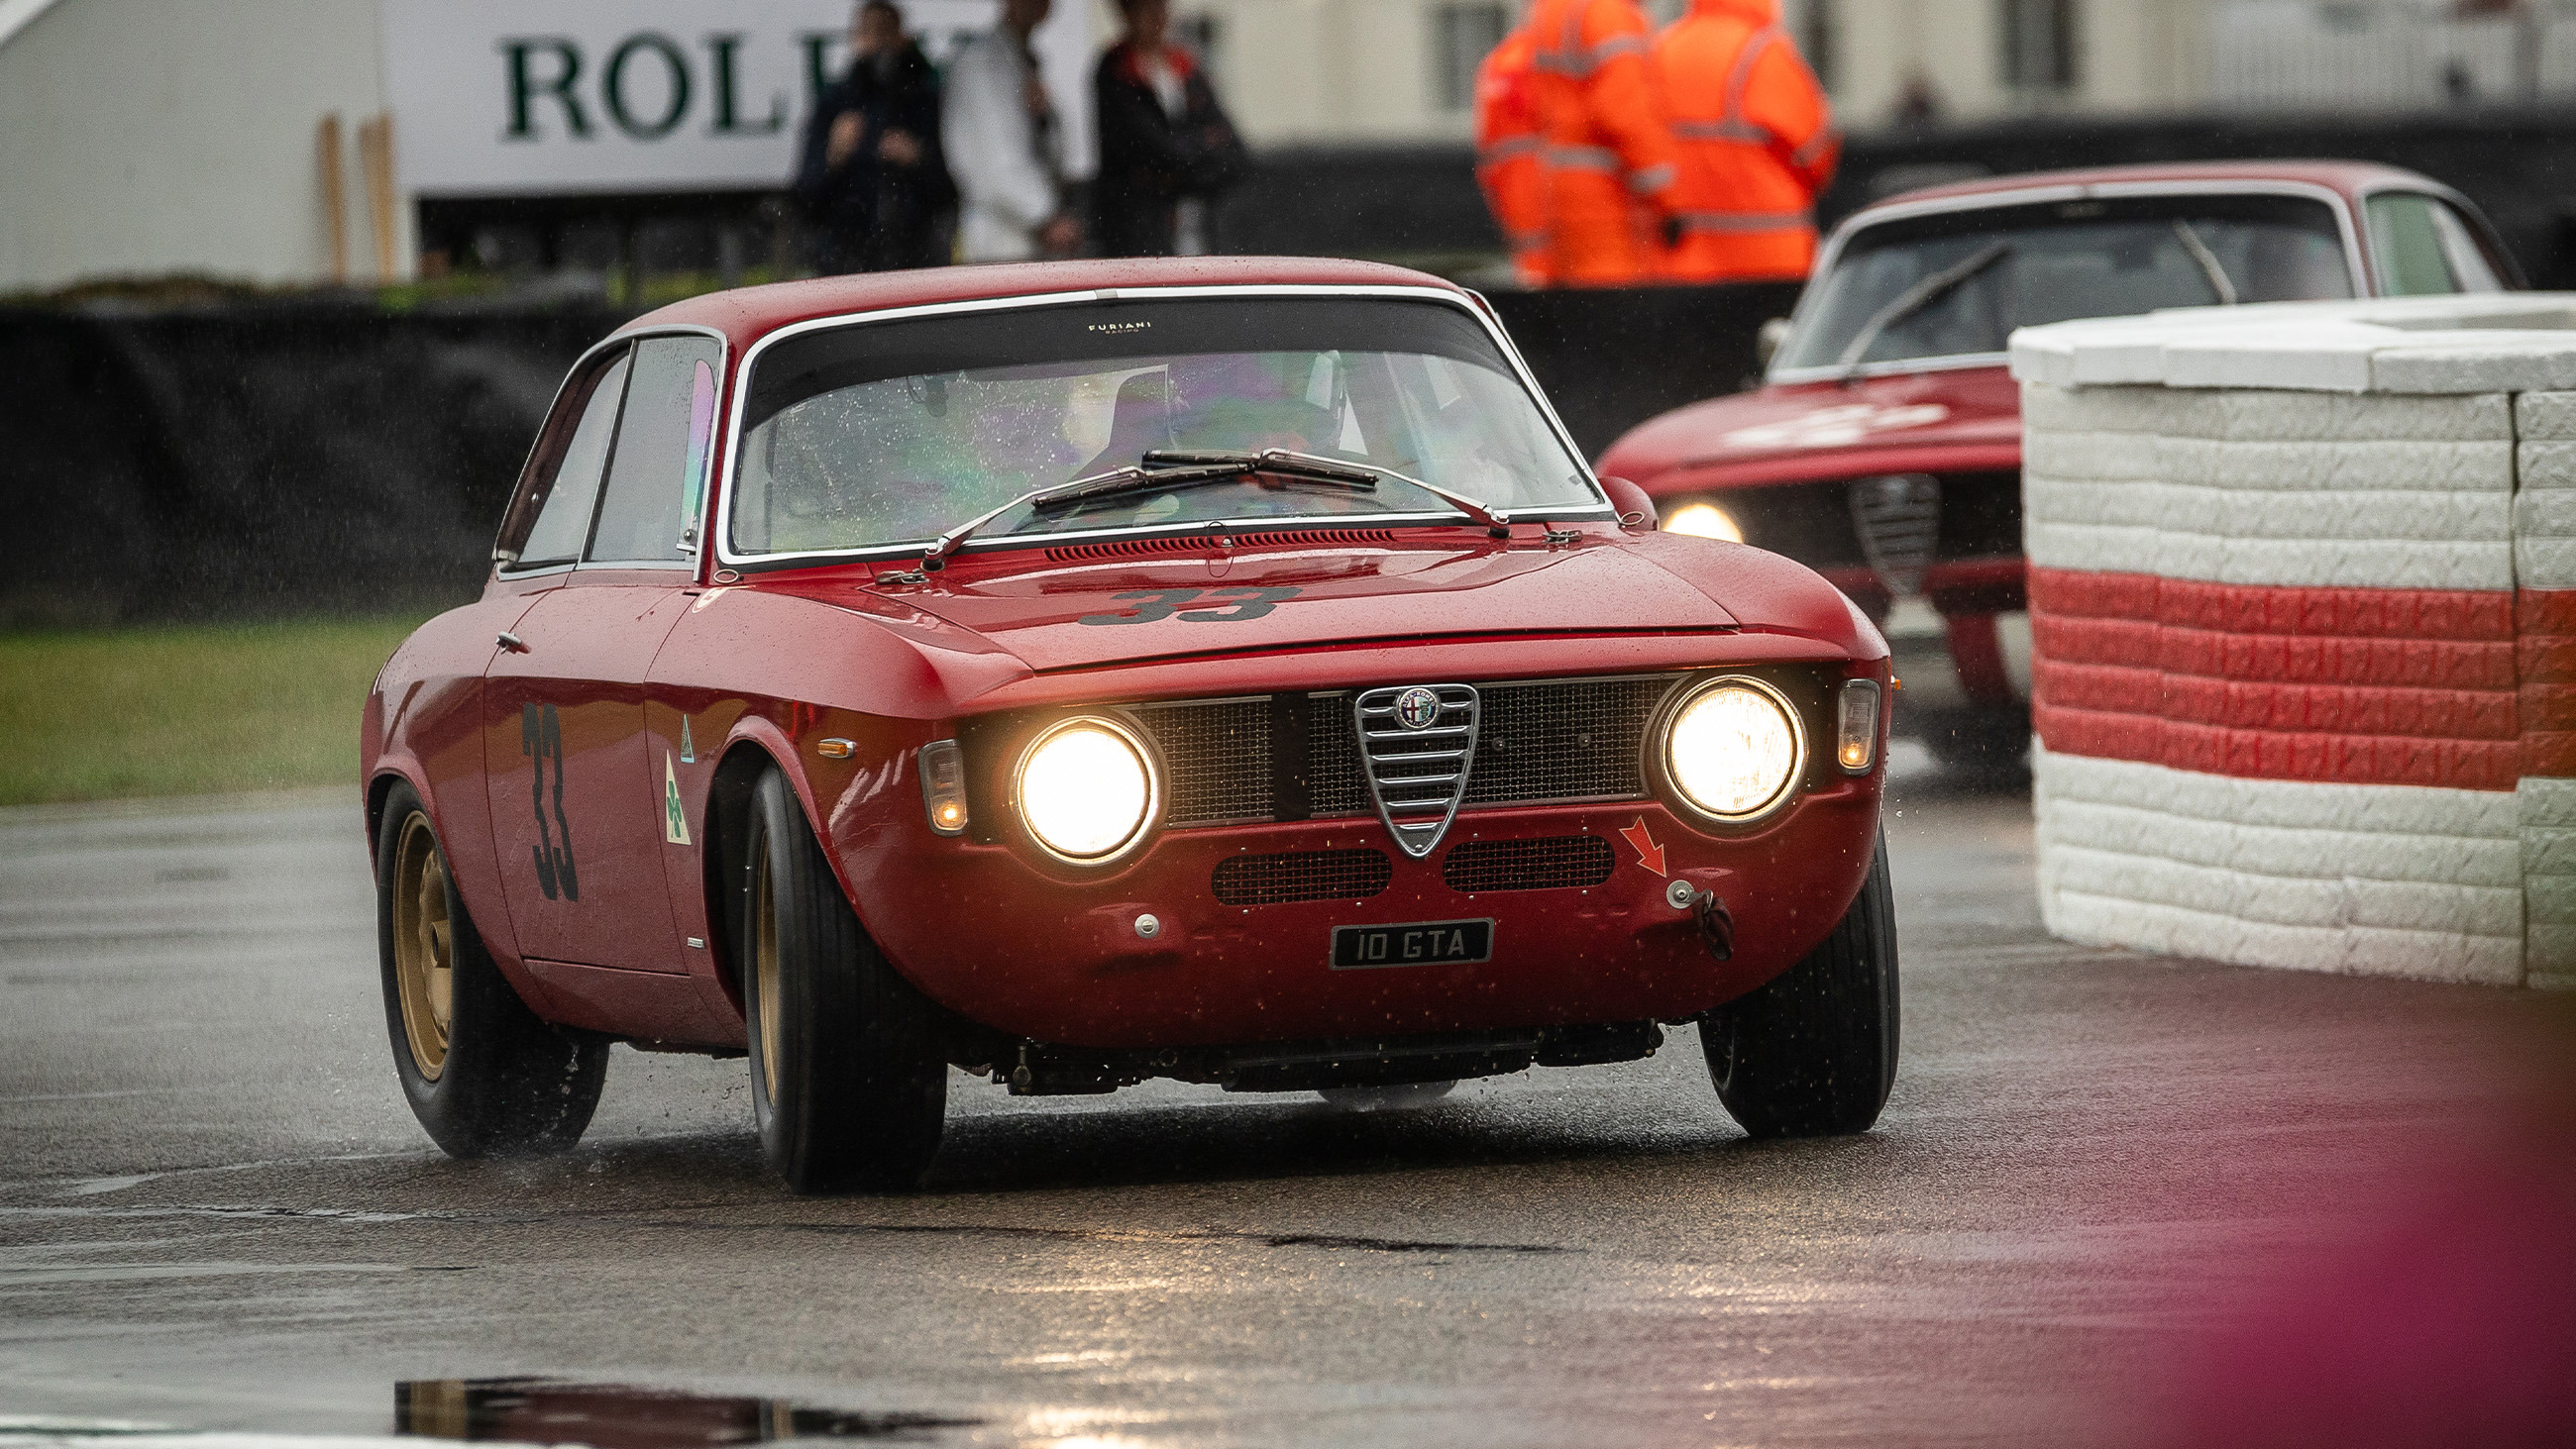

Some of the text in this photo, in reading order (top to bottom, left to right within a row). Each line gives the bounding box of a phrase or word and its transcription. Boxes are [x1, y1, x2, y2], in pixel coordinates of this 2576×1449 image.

[1088, 321, 1151, 332] FURIANI
[1077, 586, 1303, 626] 33
[522, 702, 578, 902] 33
[1357, 929, 1465, 960] 10 GTA
